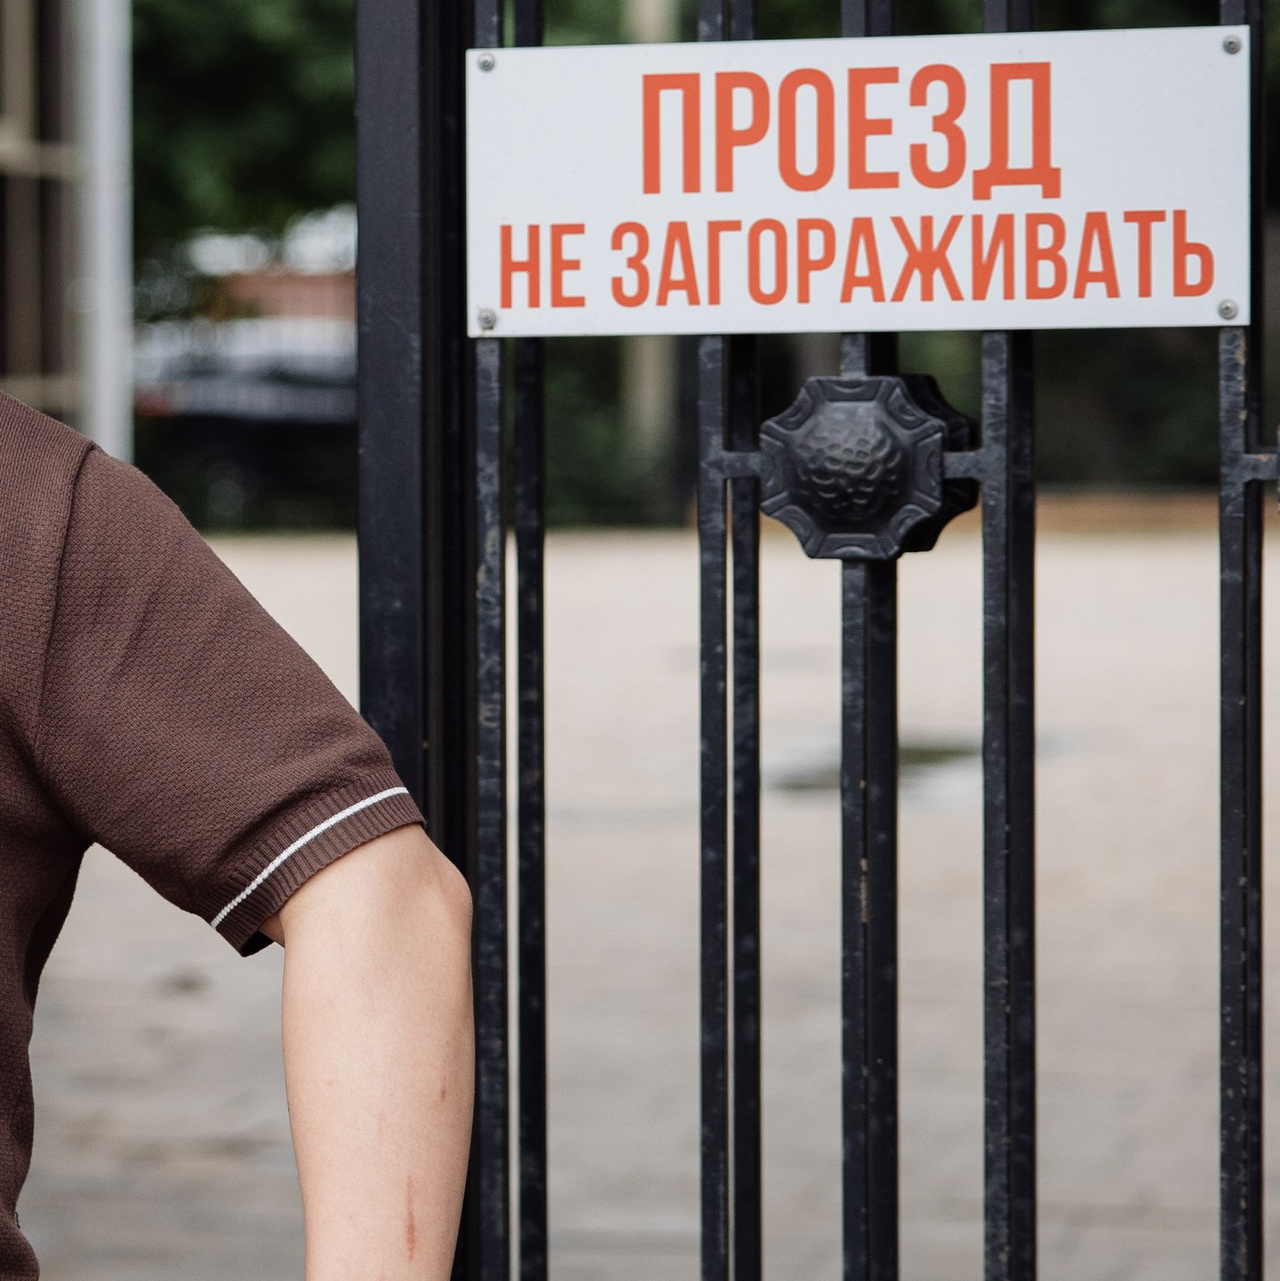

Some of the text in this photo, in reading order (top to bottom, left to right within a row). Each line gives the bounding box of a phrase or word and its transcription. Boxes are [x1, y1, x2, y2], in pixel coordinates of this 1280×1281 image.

[642, 61, 1062, 201] ПРОЕЗД
[500, 209, 1215, 309] НЕ ЗАГОРАЖИВАТЬ
